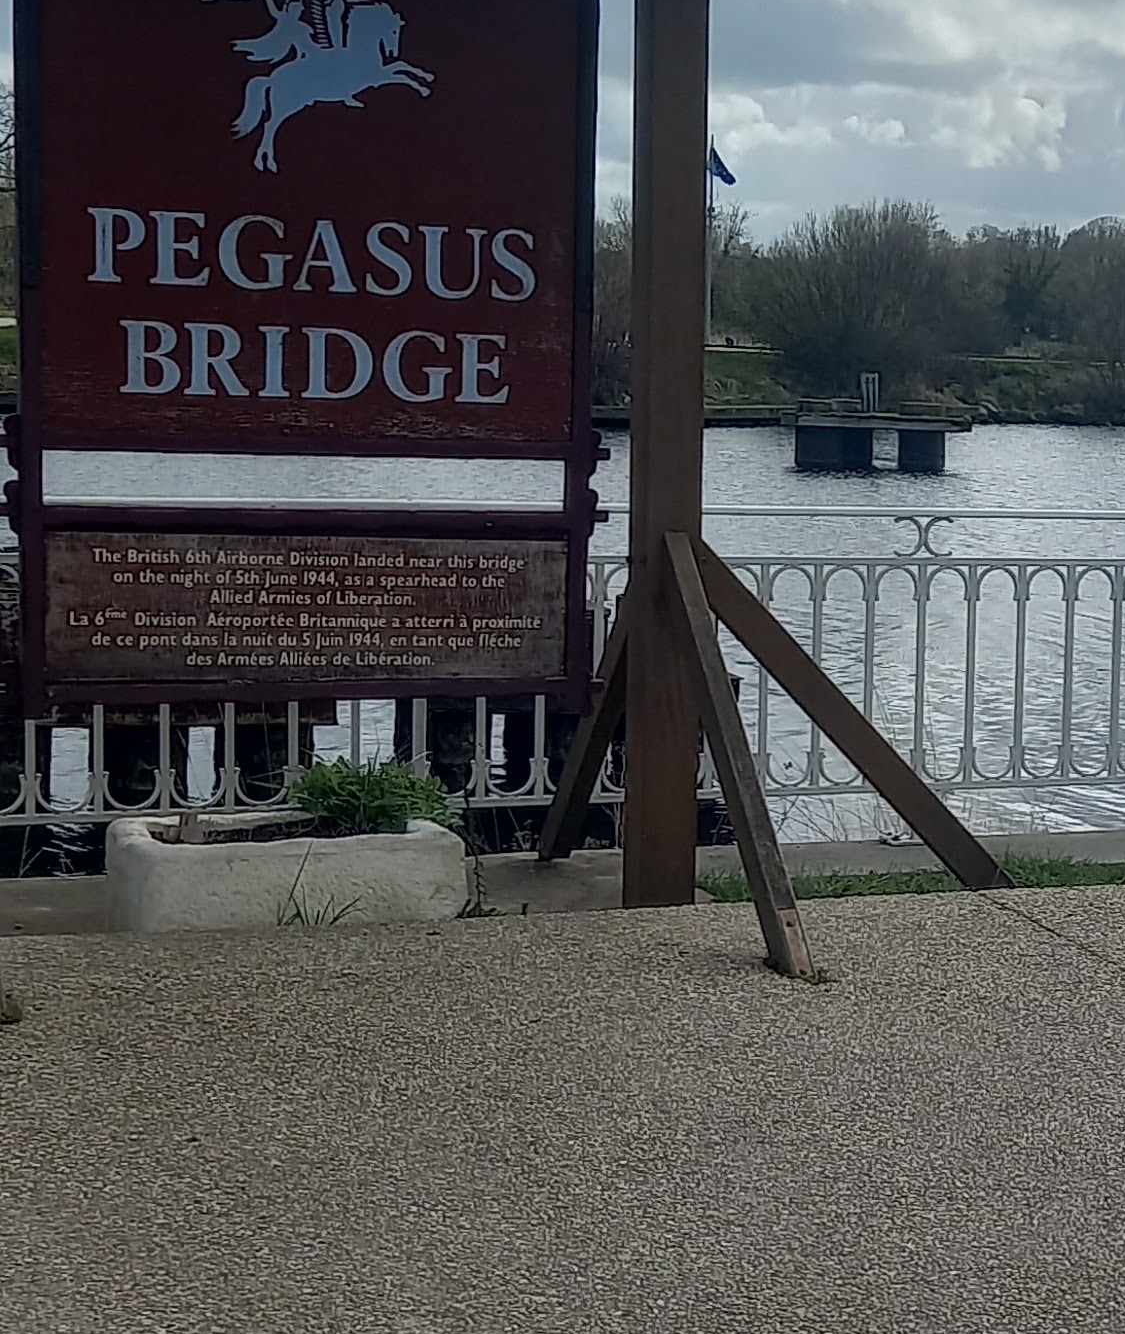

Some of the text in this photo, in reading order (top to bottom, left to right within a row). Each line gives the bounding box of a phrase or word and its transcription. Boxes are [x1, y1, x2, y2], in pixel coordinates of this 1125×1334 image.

[87, 207, 536, 303] PEGASUS
[118, 318, 511, 405] BRIDGE
[92, 548, 525, 572] The British 6th Airborne Division landed near this bridge
[113, 569, 506, 590] on the night of 5th June 1944, as a spearhead to the
[209, 589, 417, 607] Allied Armies of Liberation.
[69, 611, 89, 626] La
[134, 612, 197, 627] Division
[206, 612, 295, 630] Aéroportée
[299, 613, 387, 631] Britannique
[391, 618, 401, 628] a
[405, 613, 454, 629] atterri
[459, 614, 468, 628] à
[473, 615, 542, 632] proximité
[91, 632, 111, 647] de
[116, 635, 134, 647] ce
[139, 633, 176, 650] pont
[182, 632, 218, 647] dans
[224, 632, 237, 647] la
[242, 632, 274, 647] nuit
[278, 632, 297, 647] du
[302, 633, 310, 647] 5
[315, 633, 344, 650] Juin
[349, 633, 384, 649] 1944,
[390, 637, 407, 647] en
[412, 634, 443, 648] tant
[447, 636, 474, 651] que
[186, 651, 436, 667] des Armées Alliées de Libération.
